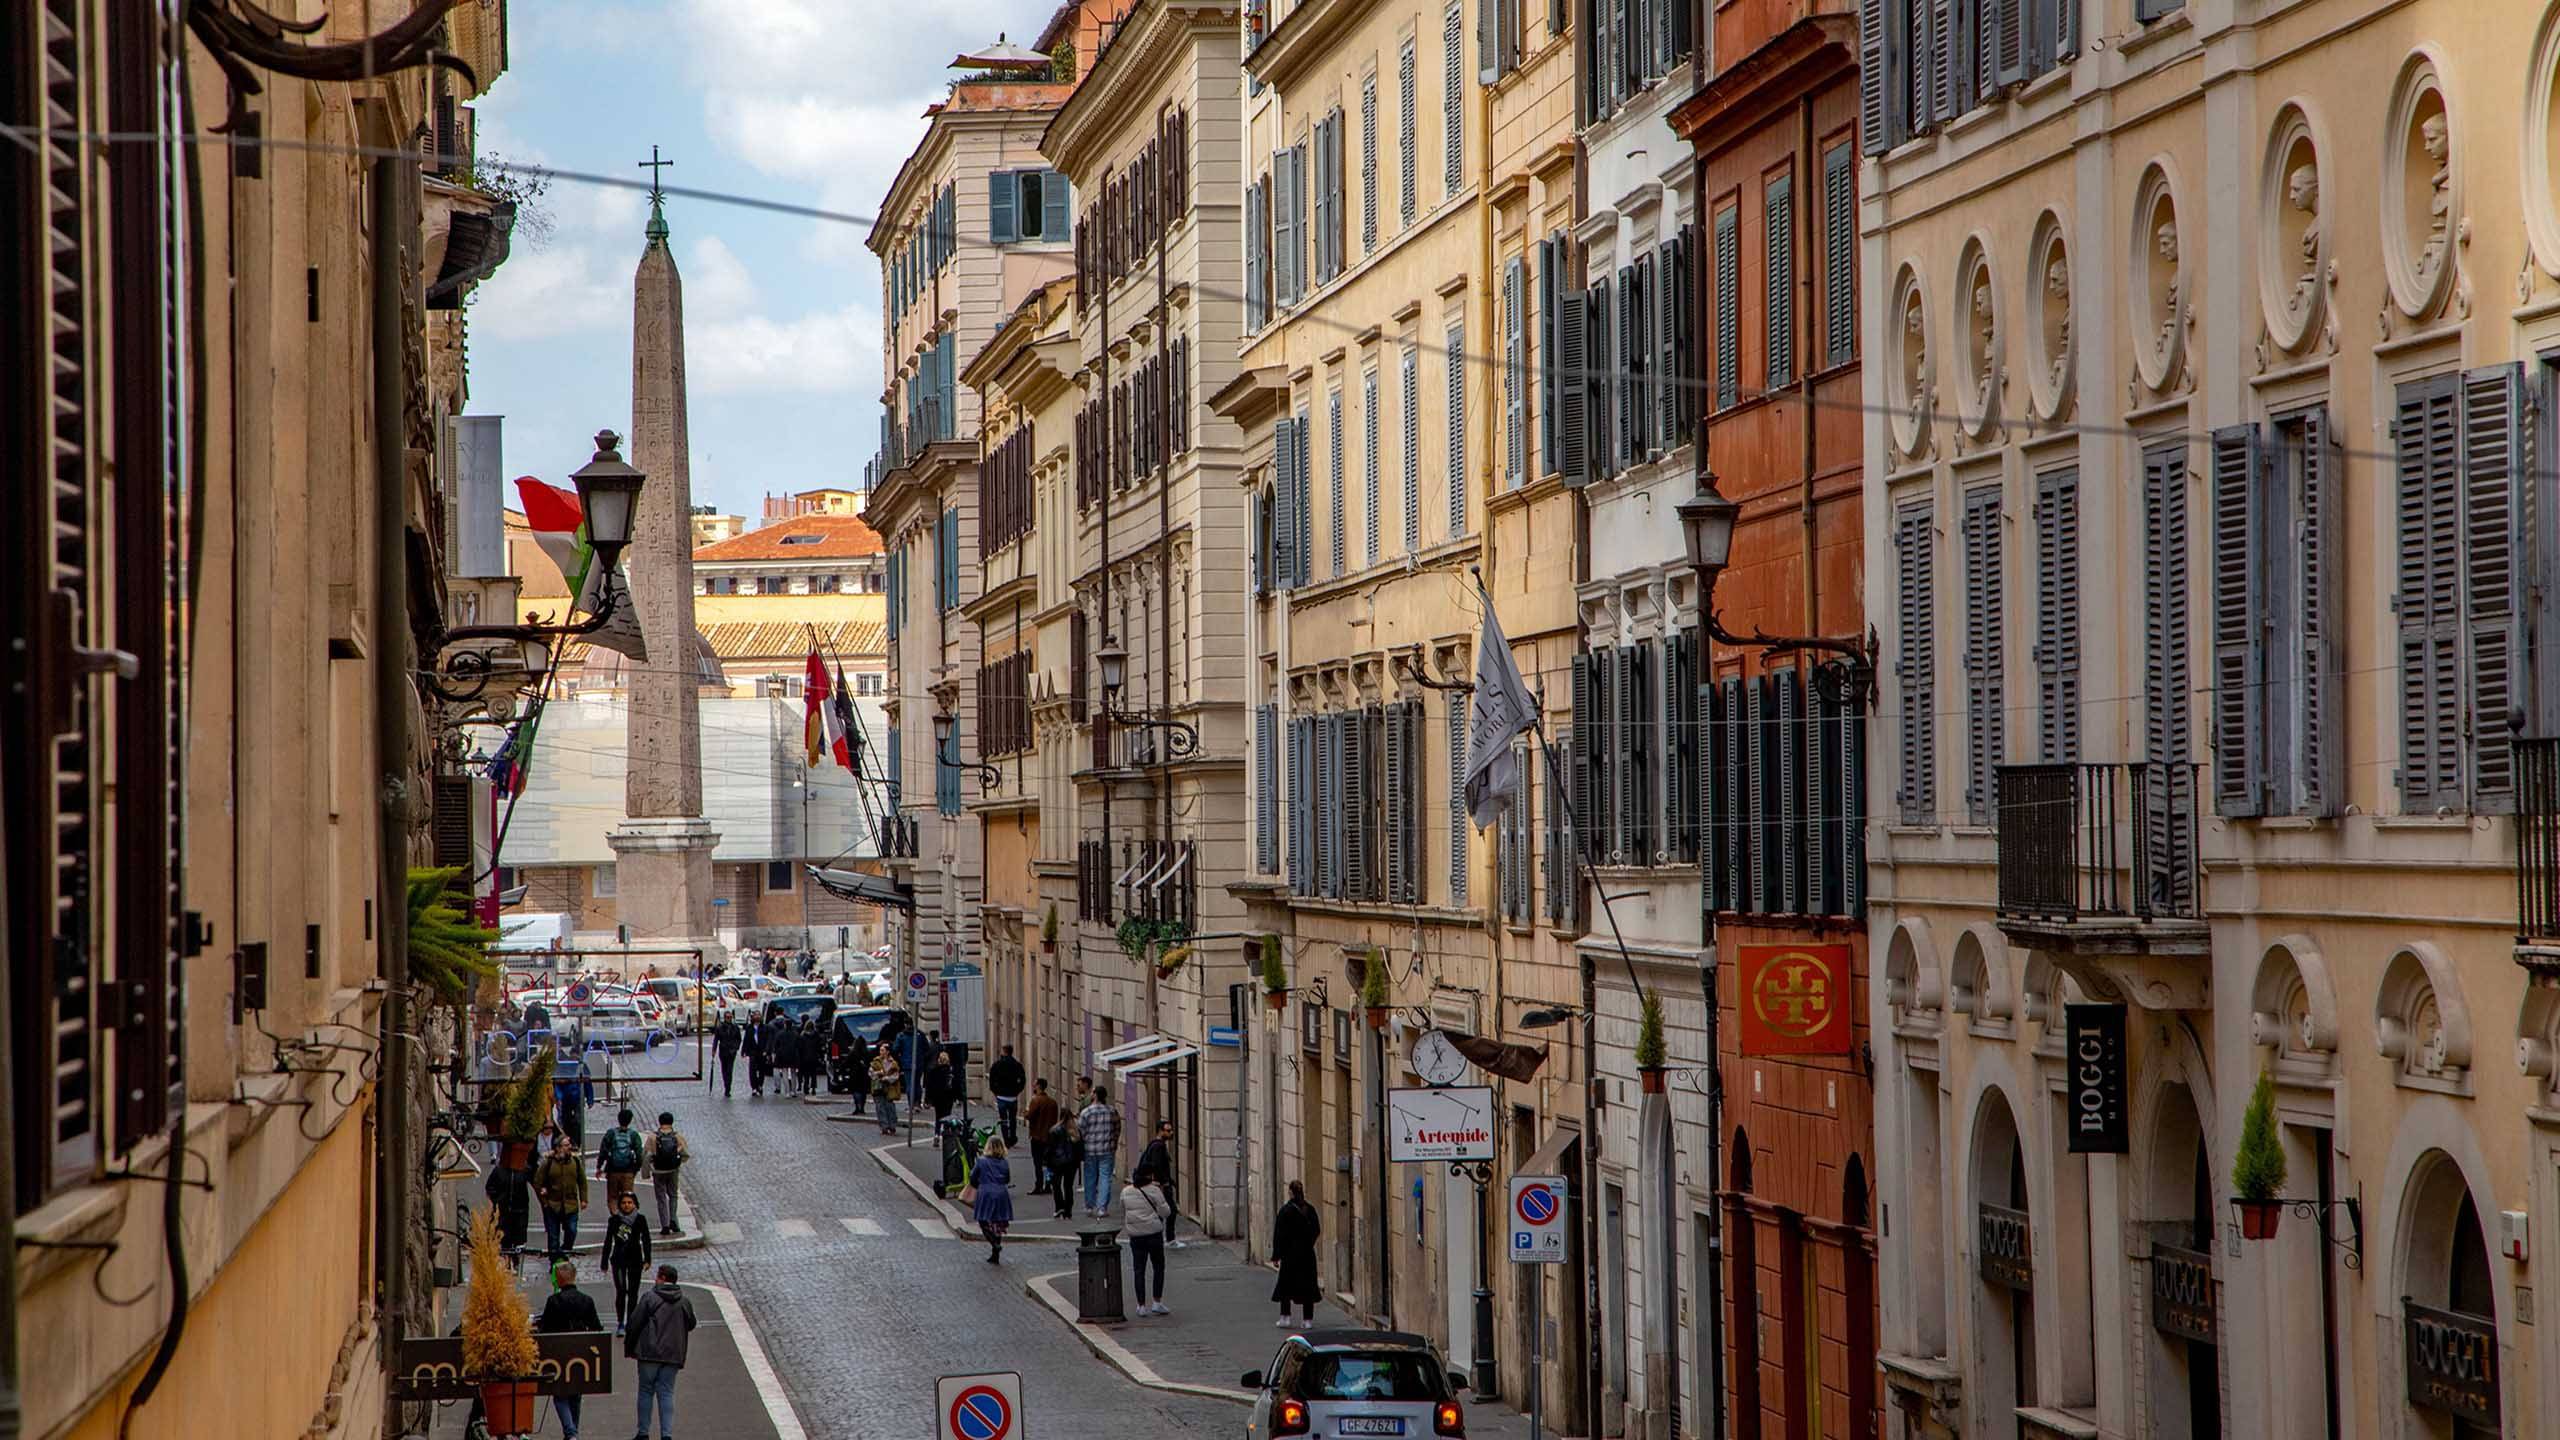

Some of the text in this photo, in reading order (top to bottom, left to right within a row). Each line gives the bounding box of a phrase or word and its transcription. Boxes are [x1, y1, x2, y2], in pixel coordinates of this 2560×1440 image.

[504, 971, 662, 1009] PIZZA
[486, 1027, 680, 1066] GELATO
[2079, 1026, 2104, 1132] BOGGI
[1417, 1128, 1489, 1144] Artemide
[1519, 1234, 1530, 1248] P
